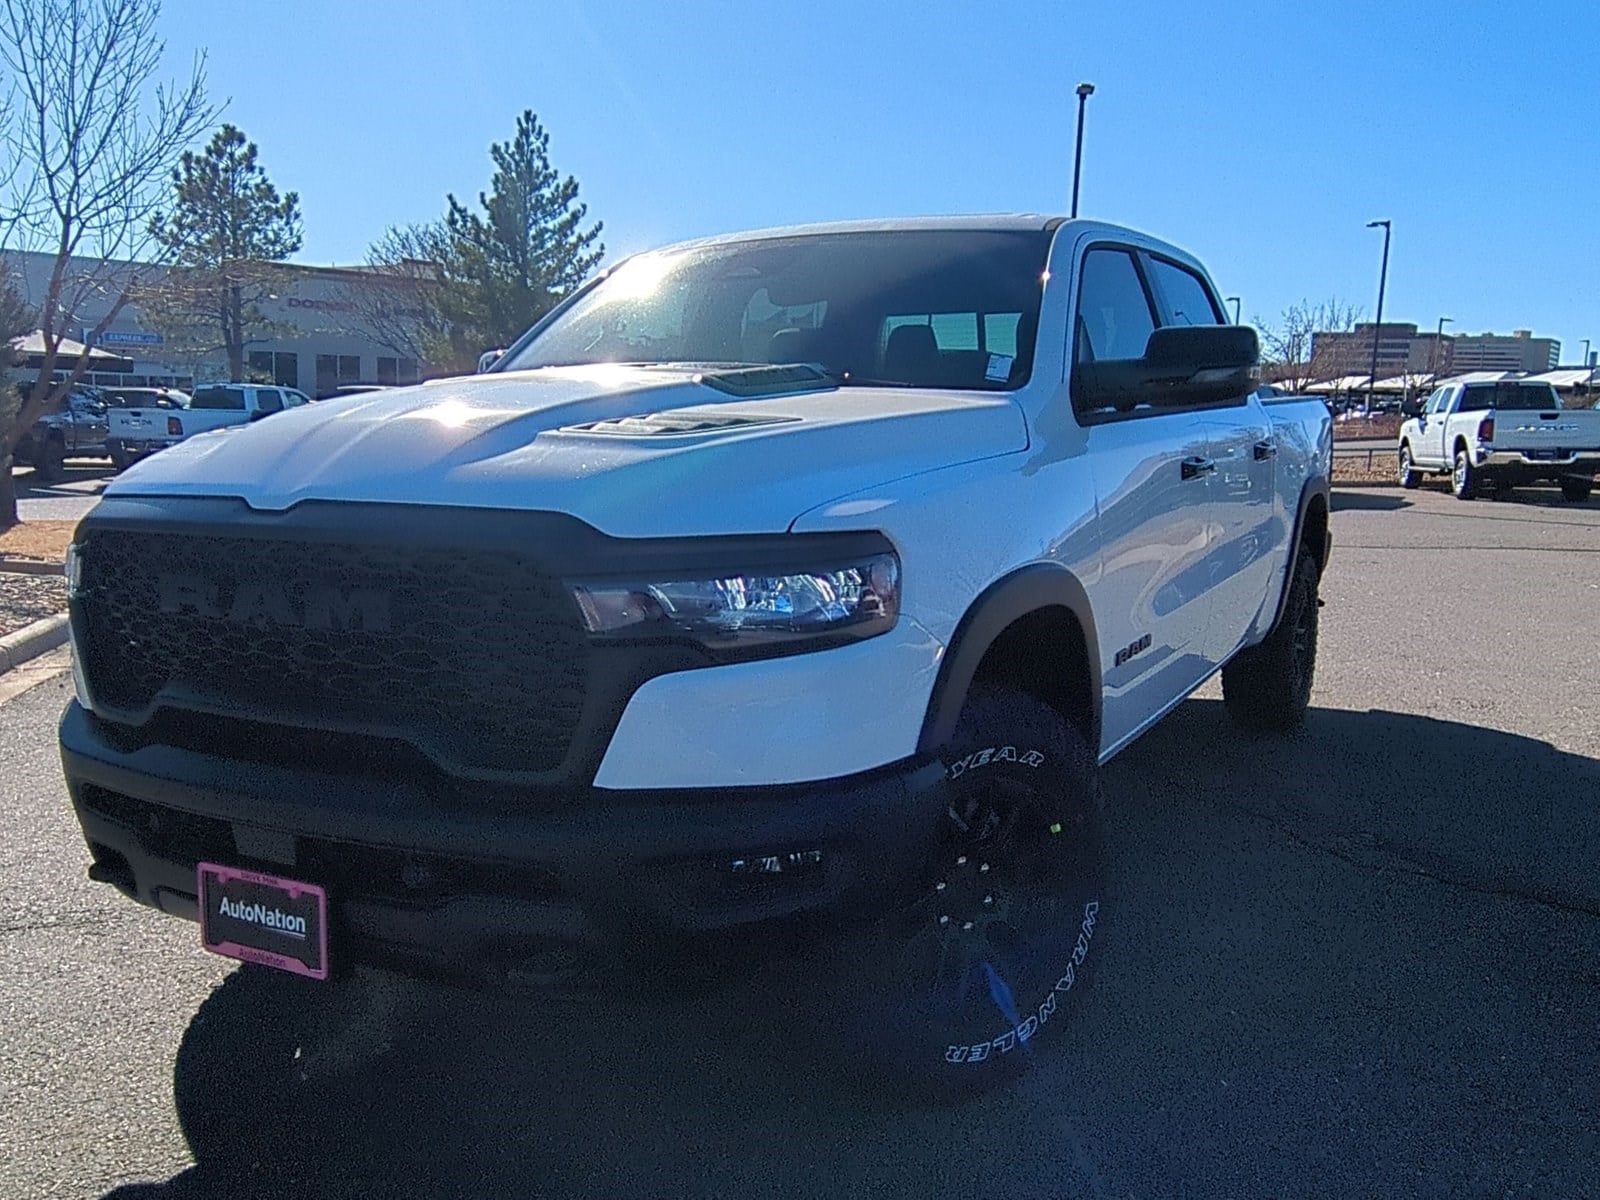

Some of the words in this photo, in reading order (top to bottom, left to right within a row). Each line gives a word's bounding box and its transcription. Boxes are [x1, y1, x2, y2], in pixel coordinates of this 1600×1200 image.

[1114, 632, 1152, 668] RAM
[945, 746, 1045, 779] YEAR
[219, 896, 306, 933] AutoNation
[945, 901, 1099, 1062] WRANGLER
